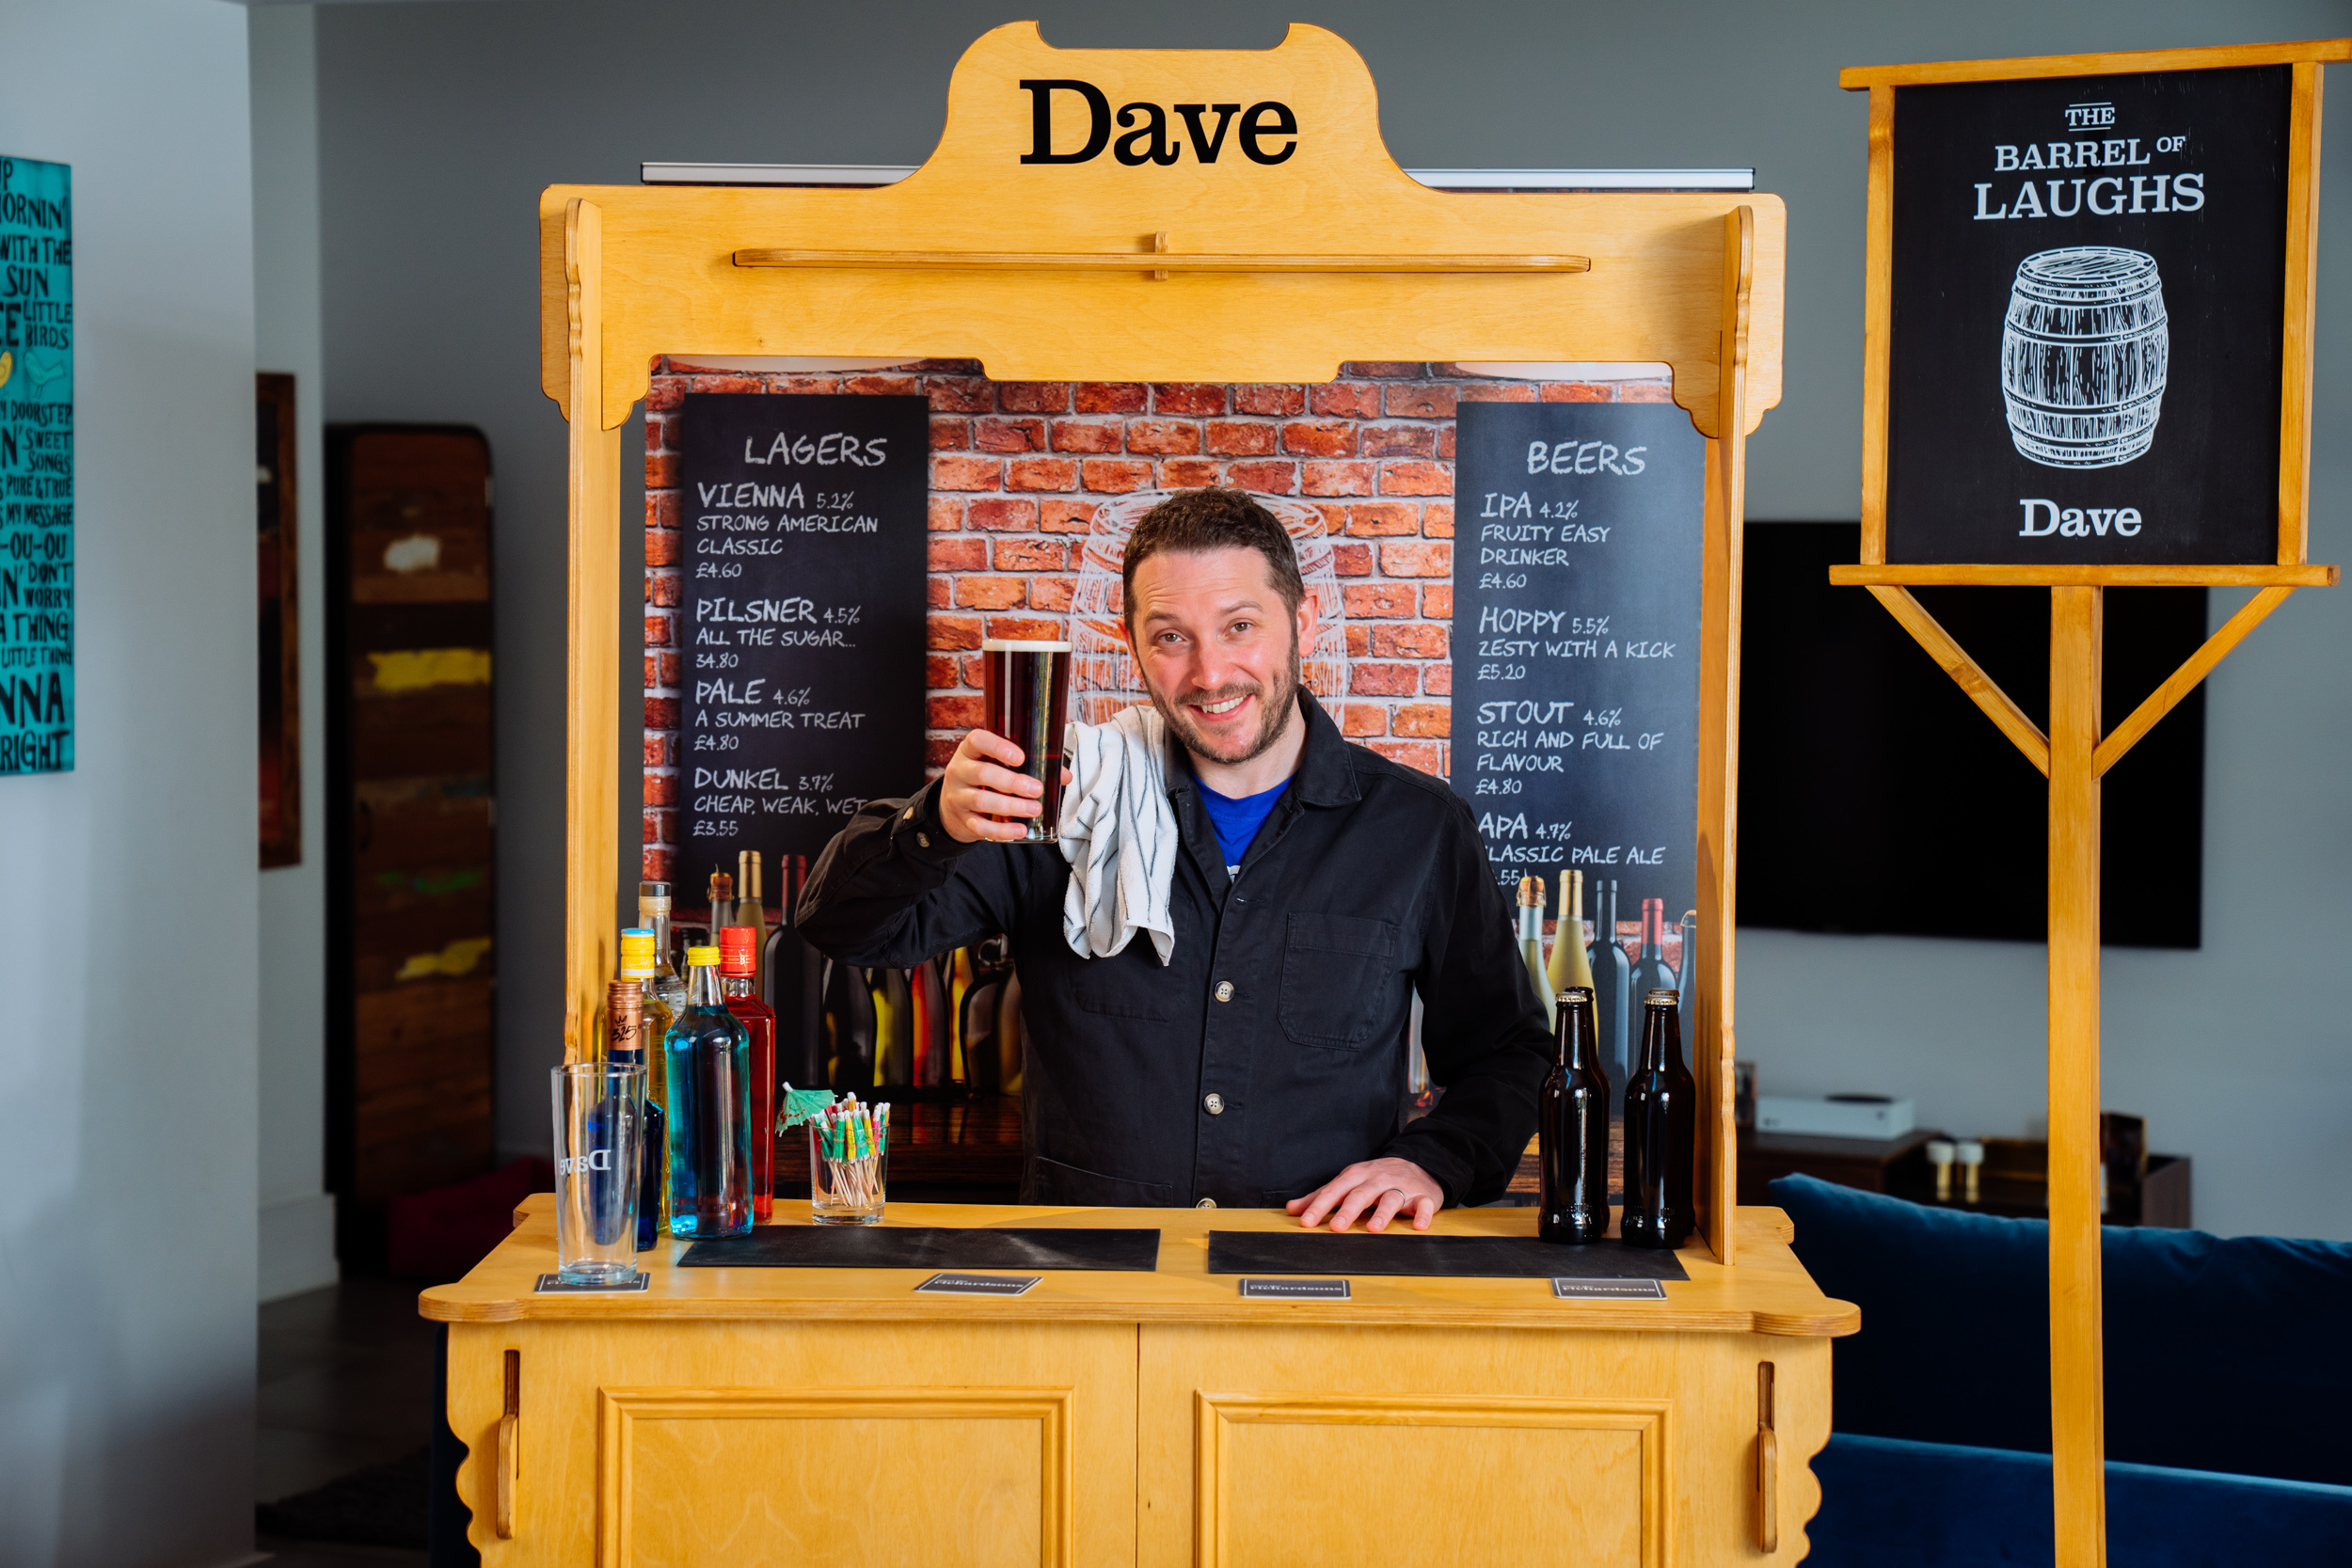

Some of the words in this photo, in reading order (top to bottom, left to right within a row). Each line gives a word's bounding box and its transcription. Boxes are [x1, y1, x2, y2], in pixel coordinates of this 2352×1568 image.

[1020, 79, 1298, 166] Dave
[2065, 106, 2115, 127] THE
[1994, 138, 2151, 171] BARREL
[2156, 135, 2185, 153] OF
[1974, 173, 2205, 220] LAUGHS
[0, 192, 67, 230] ORNIN'
[0, 233, 39, 263] WITH
[40, 236, 72, 265] THE
[2, 262, 50, 298] SUN
[24, 300, 72, 324] LITTLE
[25, 324, 69, 350] BIRDS
[10, 400, 72, 428] DOORSTEP
[22, 427, 72, 450] SWEET
[744, 432, 888, 467] LAGERS
[24, 450, 71, 475] SONGS
[1526, 439, 1647, 476] BEERS
[6, 473, 34, 497] PURE
[43, 476, 72, 499] TRUE
[697, 482, 805, 510] VIENNA
[816, 490, 854, 512] 5.2%
[6, 502, 22, 525] MY
[24, 502, 72, 528] MESSAGE
[1480, 491, 1533, 519] IPA
[1539, 499, 1580, 521] 4.2%
[2019, 499, 2142, 537] Dave
[696, 514, 770, 532] STRONG
[776, 514, 879, 533] AMERICAN
[1480, 523, 1554, 543] FRUITY
[1560, 523, 1612, 544] EASY
[696, 536, 783, 556] CLASSIC
[1480, 546, 1569, 567] DRINKER
[28, 562, 72, 583] DON'T
[695, 562, 742, 578] £4.60
[1478, 572, 1528, 590] £4.60
[24, 587, 71, 610] WORRY
[696, 596, 818, 625] PILSNER
[822, 605, 861, 626] 4.5%
[1478, 605, 1566, 635] HOPPY
[1572, 615, 1611, 637] 5.5%
[12, 611, 69, 643] THING
[695, 626, 731, 645] ALL
[736, 627, 776, 646] THE
[1, 646, 37, 668] LITTLE
[40, 646, 72, 666] THING
[695, 652, 739, 669] 34.80
[1478, 638, 1540, 657] ZESTY
[1545, 639, 1597, 658] WITH
[1604, 640, 1618, 658] A
[1625, 641, 1677, 659] KICK
[1476, 663, 1526, 681] £5.20
[695, 677, 766, 705] PALE
[772, 687, 811, 707] 4.6%
[694, 708, 708, 727] A
[714, 710, 795, 729] SUMMER
[799, 711, 866, 730] TREAT
[1476, 699, 1575, 725] STOUT
[1582, 706, 1623, 729] 4.6%
[693, 734, 739, 752] £4.80
[1477, 729, 1528, 749] RICH
[1534, 730, 1575, 749] AND
[1581, 731, 1631, 751] FULL
[1638, 732, 1665, 752] OF
[1476, 752, 1565, 773] FLAVOUR
[693, 767, 789, 790] DUNKEL
[798, 772, 834, 793] 3.7%
[1474, 777, 1522, 795] £4.80
[693, 794, 755, 816] CHEAP,
[761, 796, 819, 816] WEAK,
[825, 797, 868, 815] WET
[692, 819, 739, 837] £3.55
[1478, 812, 1529, 840] APA
[1534, 820, 1572, 842] 4.7%
[1486, 844, 1564, 863] LASSIC
[1571, 845, 1621, 864] PALE
[1626, 846, 1666, 865] ALE
